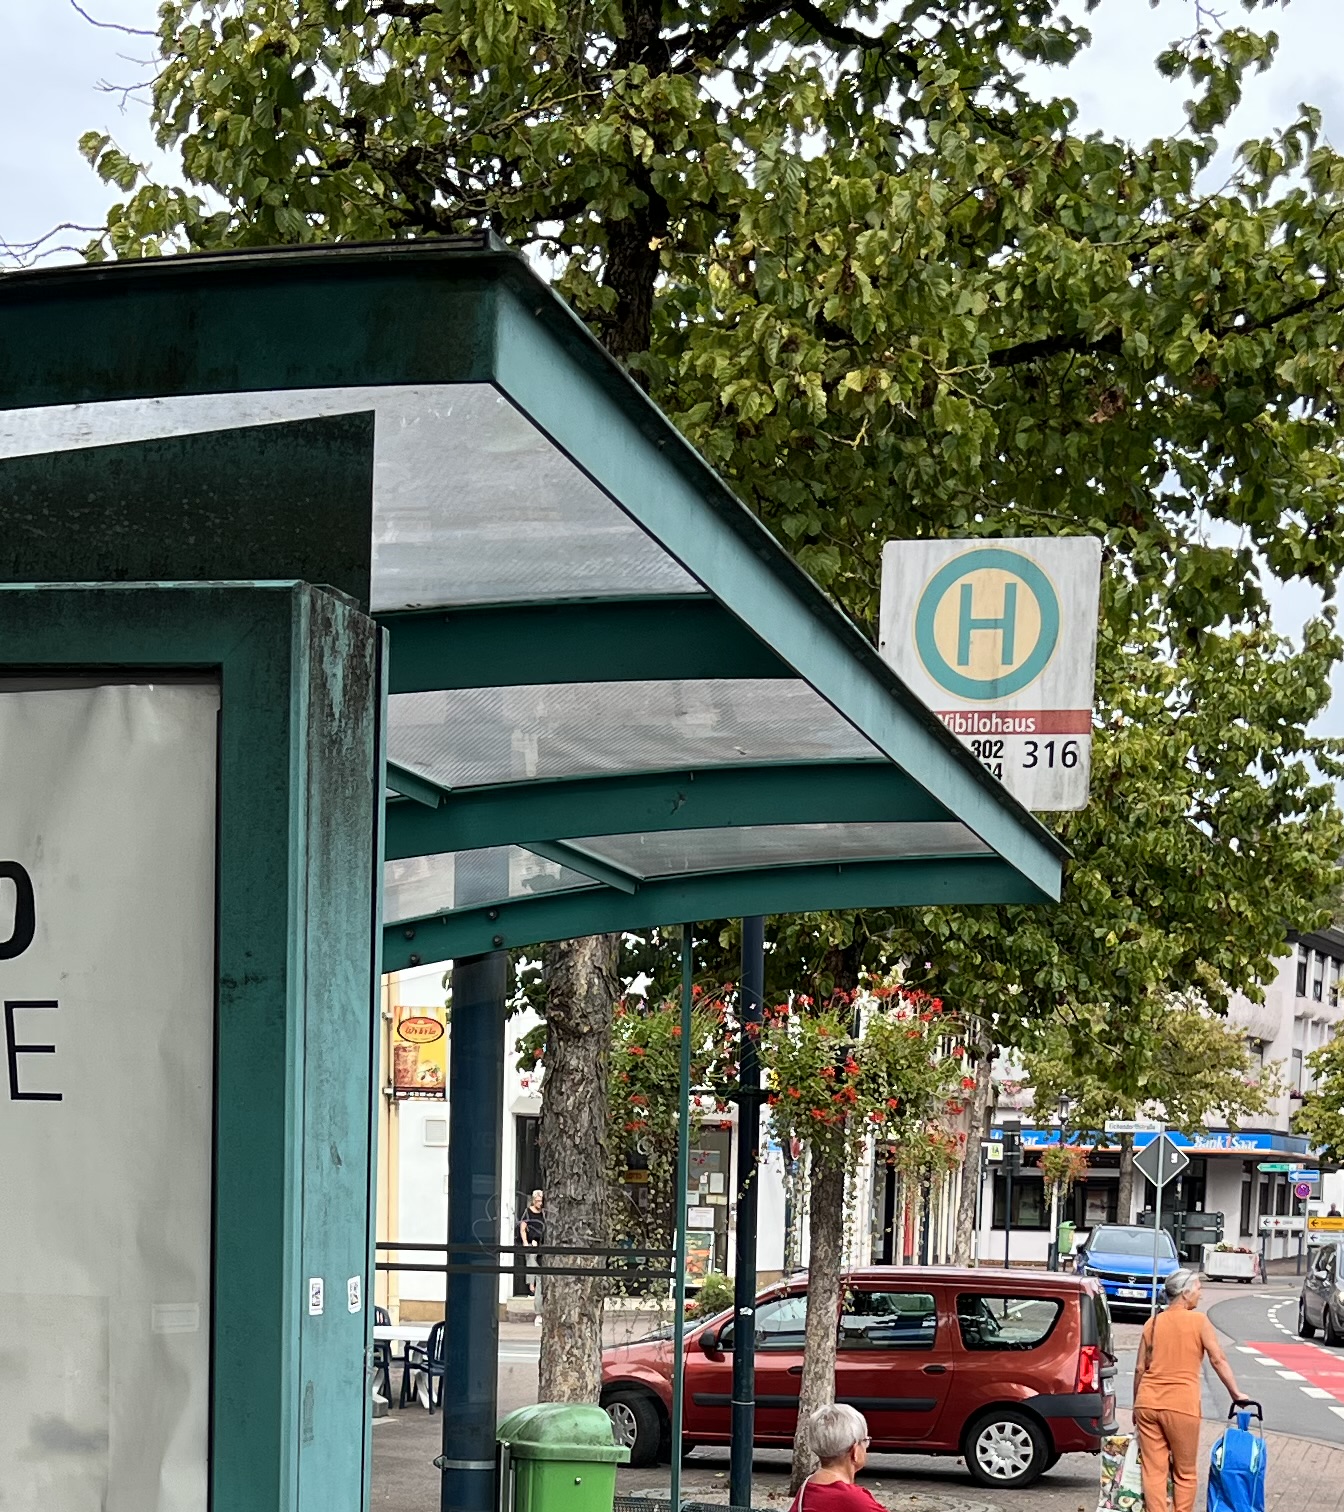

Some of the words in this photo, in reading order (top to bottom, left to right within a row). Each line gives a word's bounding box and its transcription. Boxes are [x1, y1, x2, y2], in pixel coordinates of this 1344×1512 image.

[957, 582, 1018, 667] H
[971, 739, 1004, 759] 302
[1022, 740, 1078, 769] 316
